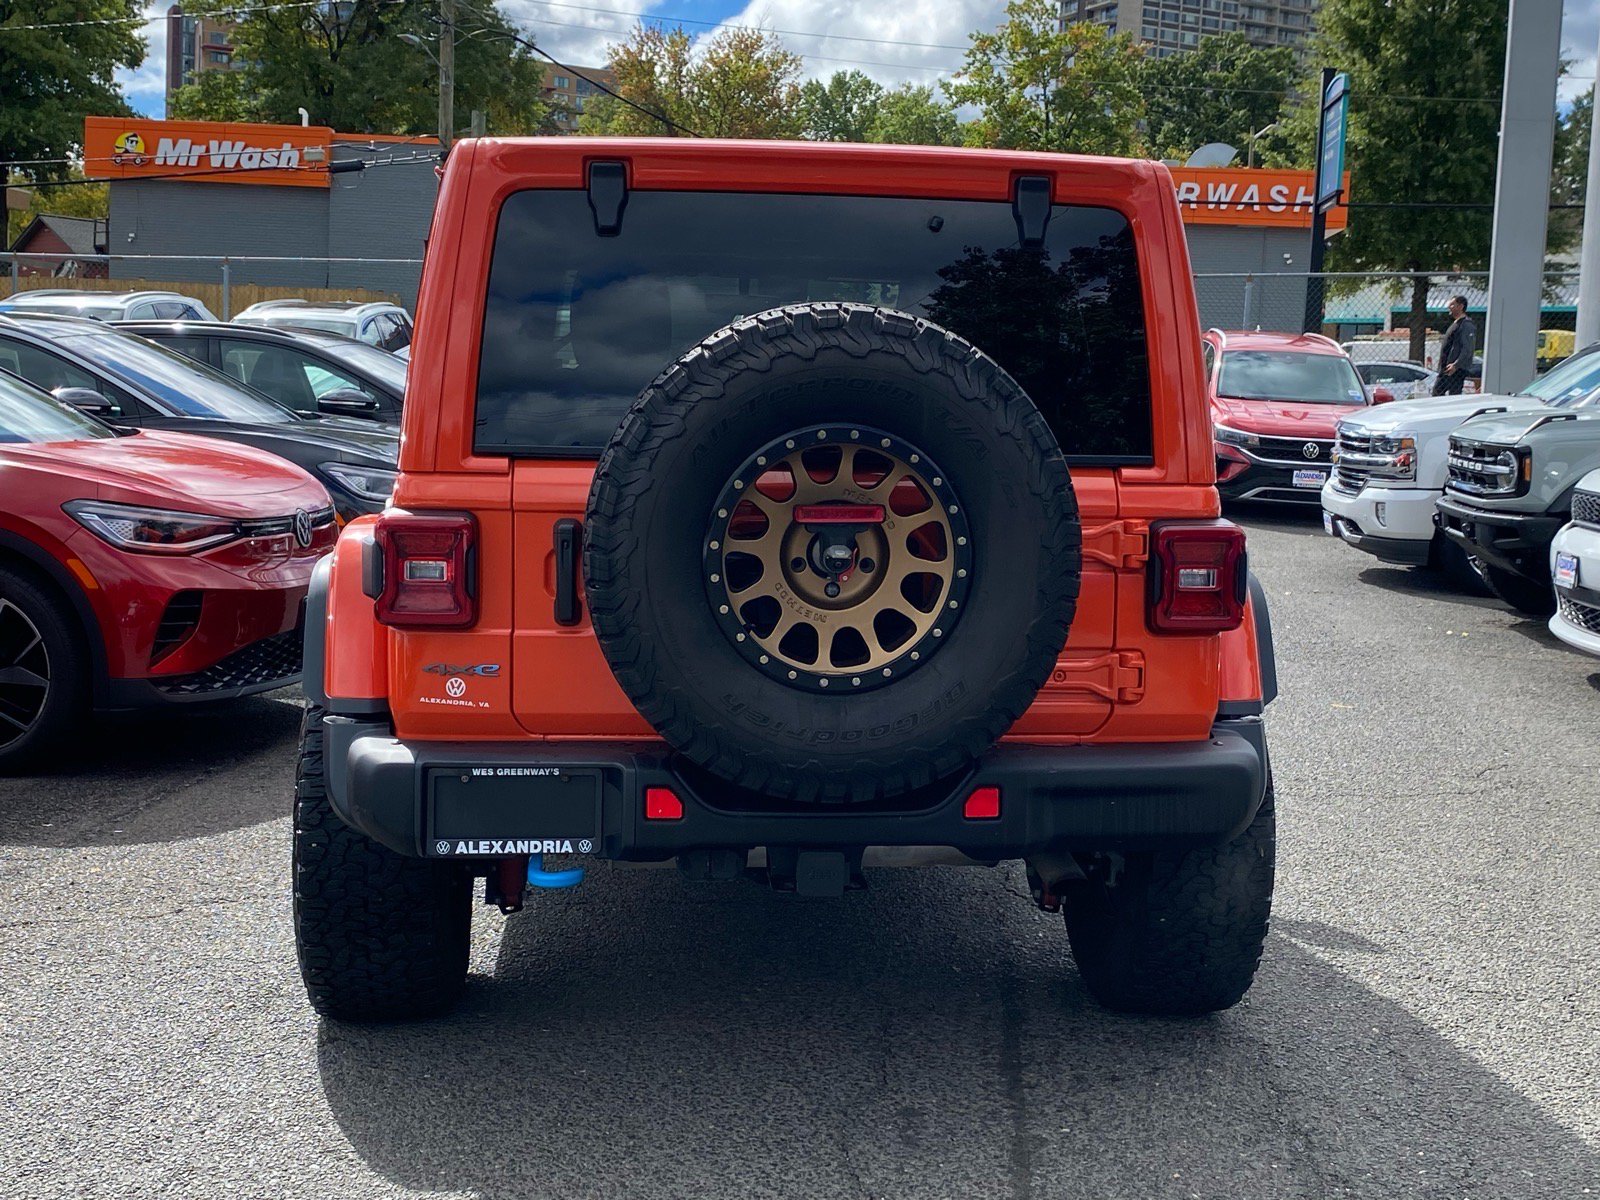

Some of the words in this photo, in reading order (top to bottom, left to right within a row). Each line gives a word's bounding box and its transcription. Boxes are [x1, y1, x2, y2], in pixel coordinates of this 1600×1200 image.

[155, 137, 206, 167] Mr
[209, 139, 300, 170] Wash
[1176, 182, 1315, 213] RWASH
[774, 582, 828, 624] METHOD
[419, 696, 476, 708] ALEXANDRIA,
[472, 767, 494, 776] WES
[497, 767, 560, 776] GREENWAY'S
[455, 840, 574, 855] ALEXANDRIA
